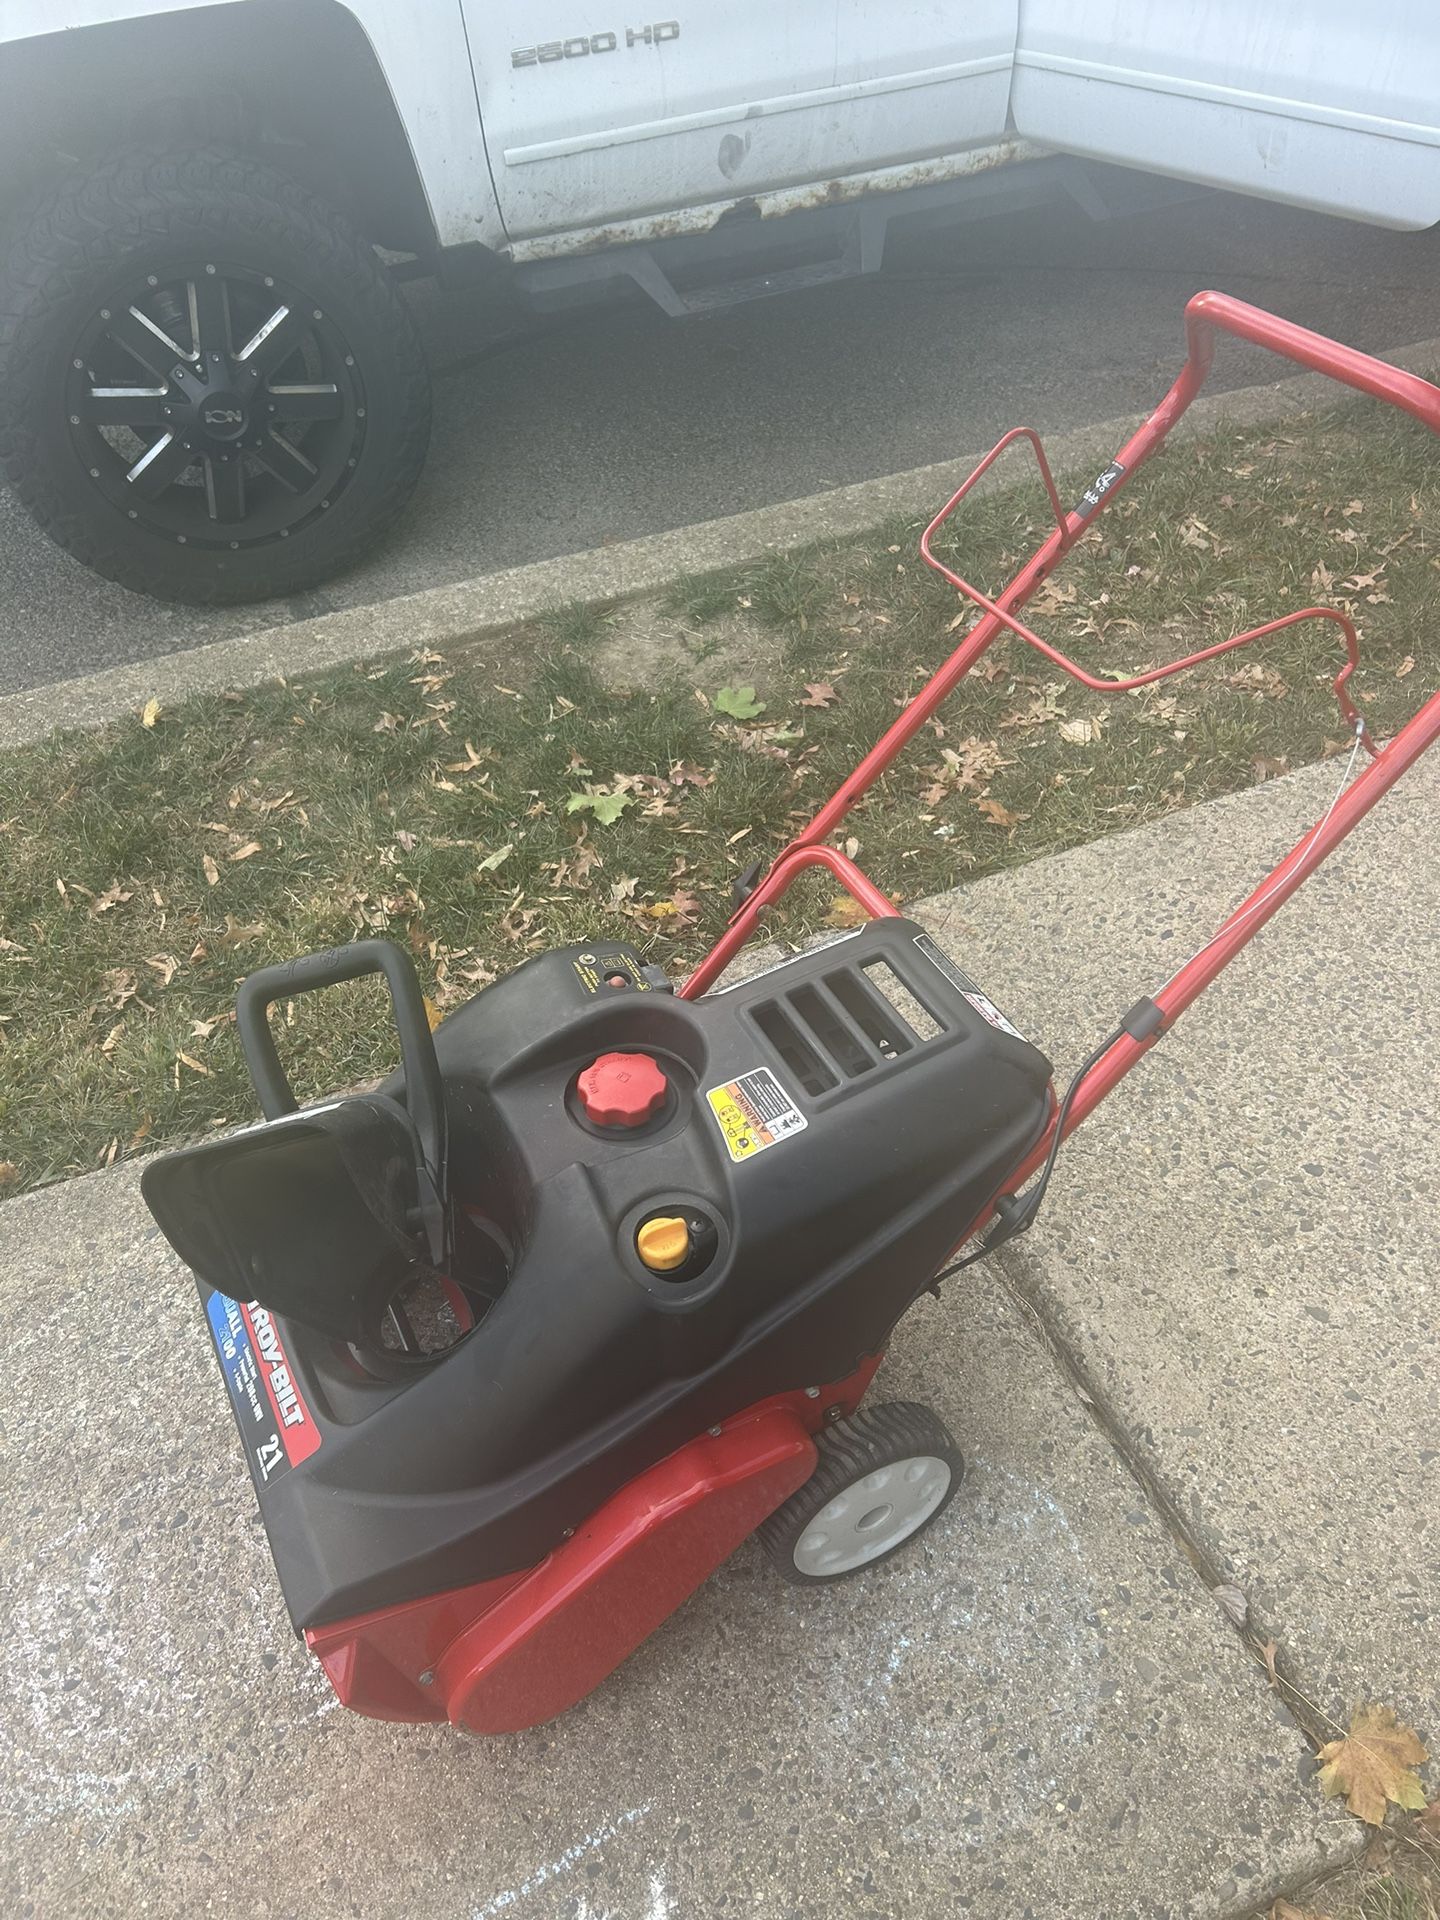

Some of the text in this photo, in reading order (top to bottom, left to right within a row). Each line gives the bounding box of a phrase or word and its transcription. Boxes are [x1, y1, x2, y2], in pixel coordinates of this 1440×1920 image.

[511, 20, 680, 68] 2500 HD
[735, 1094, 763, 1127] WARNING
[218, 1323, 237, 1360] 2100
[260, 1433, 284, 1473] 21
